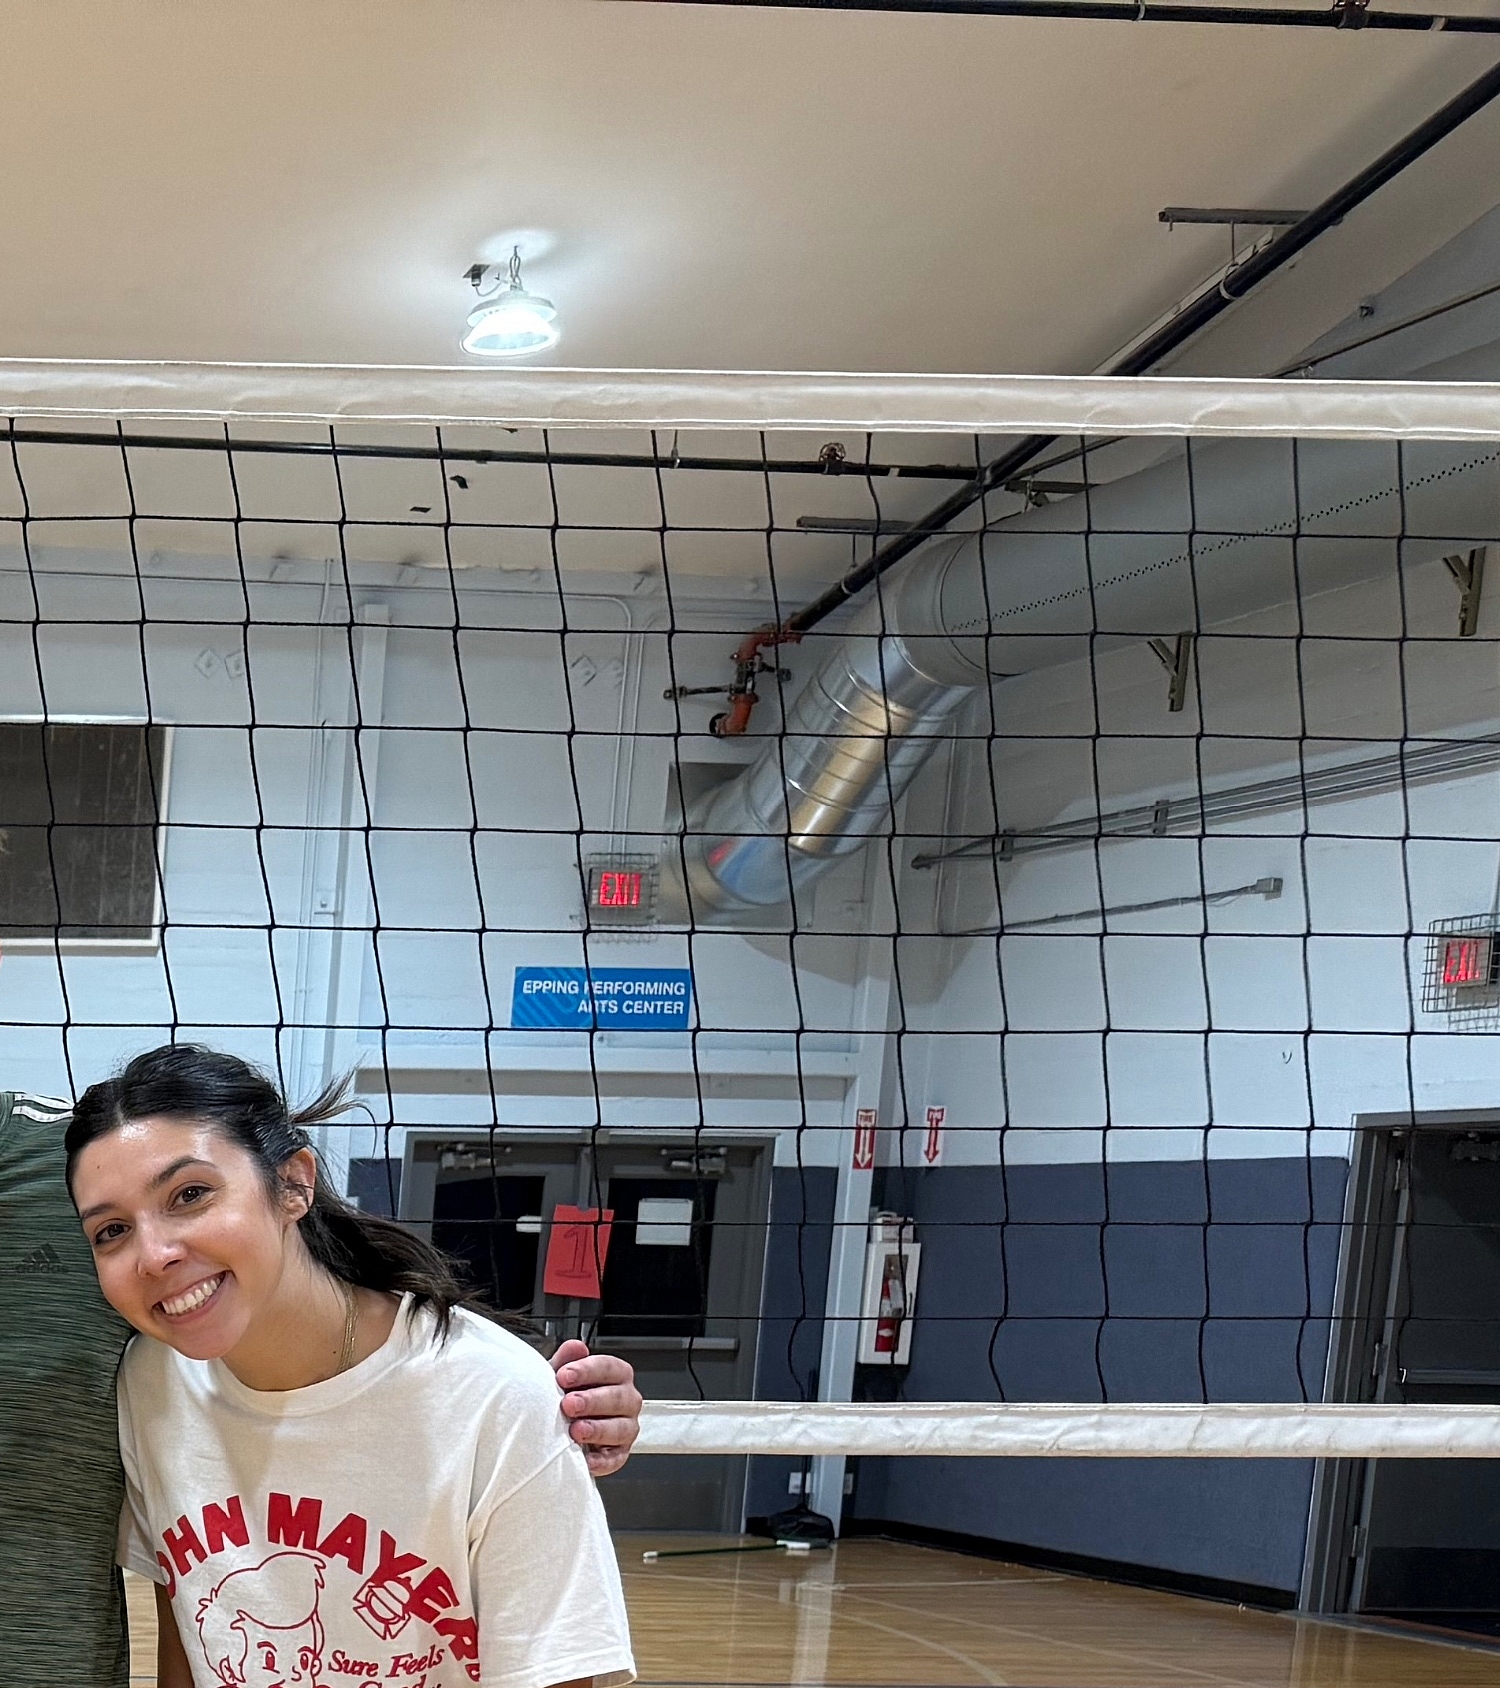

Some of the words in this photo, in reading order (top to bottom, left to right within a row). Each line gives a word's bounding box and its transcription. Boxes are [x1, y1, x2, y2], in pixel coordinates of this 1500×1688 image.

[599, 872, 642, 907] EXIT
[523, 980, 579, 994] EPPING
[622, 1000, 685, 1014] CENTER
[327, 1649, 379, 1677] Sure
[385, 1645, 445, 1678] Feels
